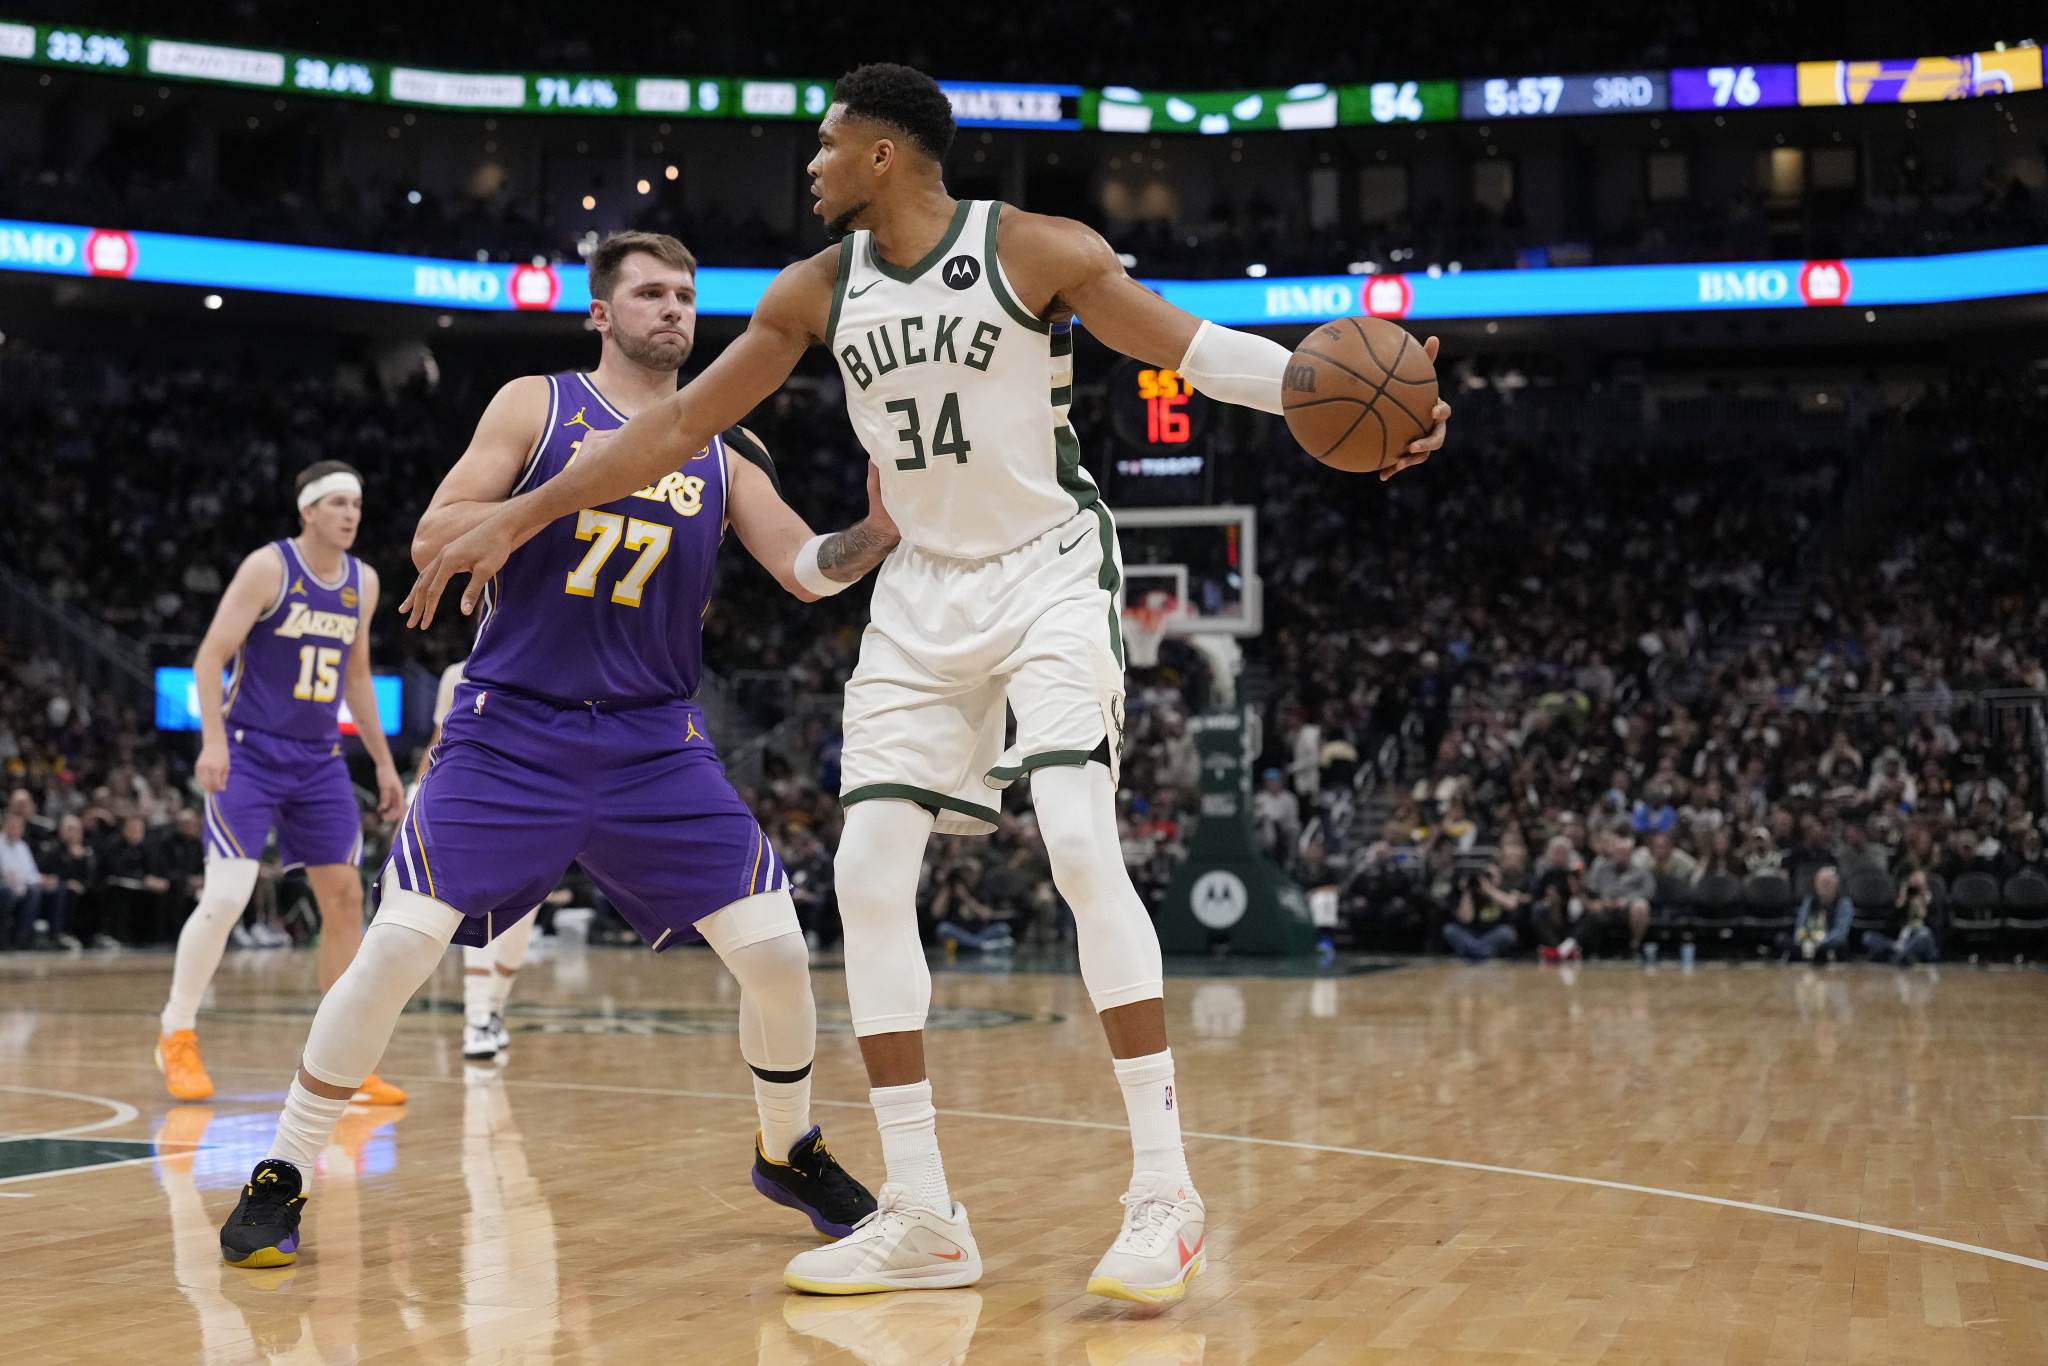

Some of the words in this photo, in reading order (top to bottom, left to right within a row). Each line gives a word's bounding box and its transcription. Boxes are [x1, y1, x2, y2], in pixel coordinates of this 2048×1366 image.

[535, 78, 618, 109] 71.4%
[804, 85, 826, 114] 3
[1370, 80, 1424, 122] 54
[1484, 76, 1565, 116] 5:57
[1592, 75, 1654, 109] 3RD
[1707, 65, 1762, 107] 76
[414, 265, 500, 302] BMO
[1265, 283, 1352, 316] BMO
[1699, 269, 1788, 302] BMO
[841, 315, 1002, 391] BUCKS
[885, 392, 971, 470] 34
[1147, 394, 1190, 444] 16
[565, 508, 672, 608] 77
[274, 602, 358, 645] LAKERS
[293, 645, 342, 703] 15
